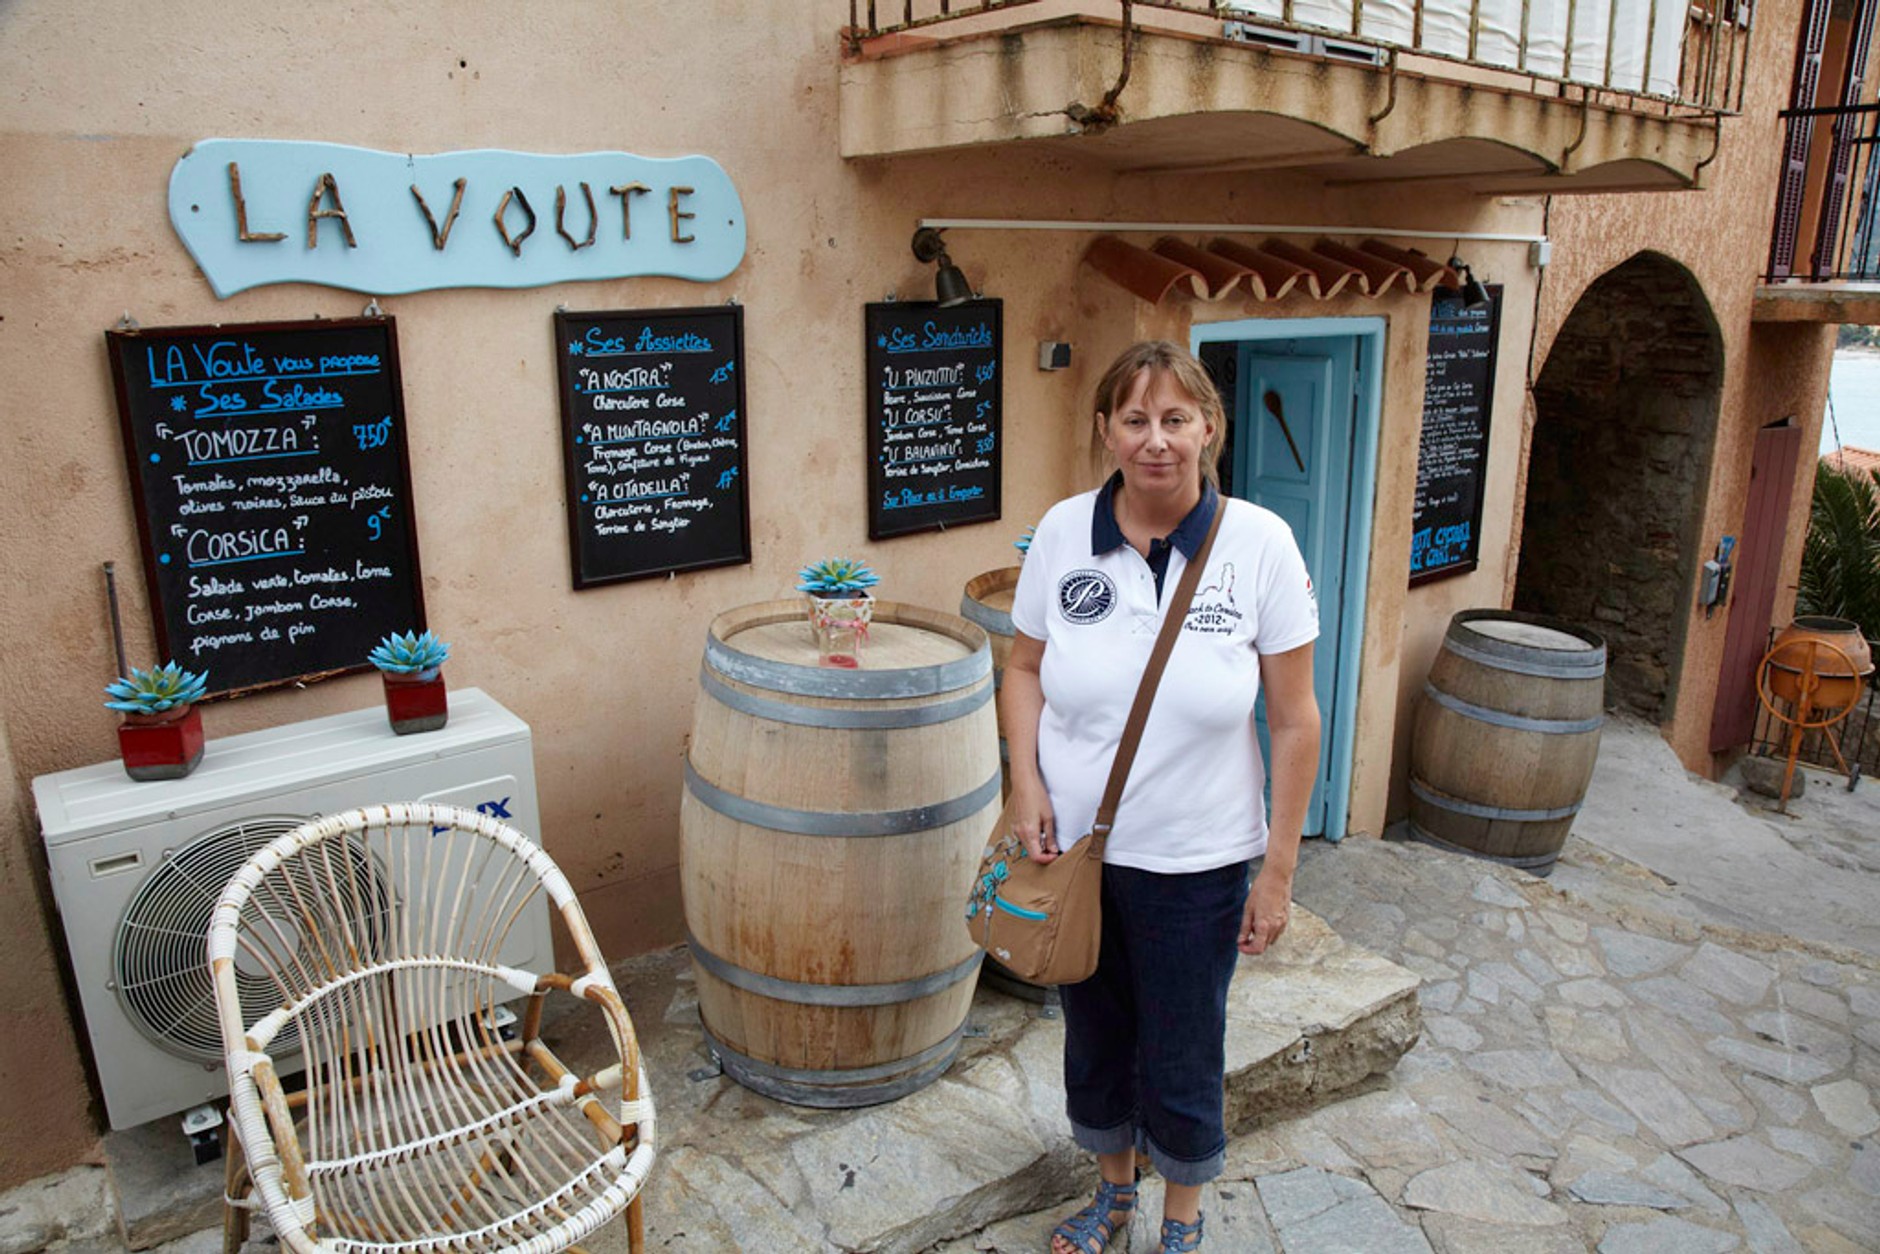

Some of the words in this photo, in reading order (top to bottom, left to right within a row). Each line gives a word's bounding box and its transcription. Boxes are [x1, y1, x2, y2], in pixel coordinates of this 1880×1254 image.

[228, 161, 357, 249] LA
[410, 176, 697, 258] VOUTE
[585, 327, 625, 354] Ses
[635, 326, 712, 351] Assiettes
[147, 345, 188, 384] LA
[193, 342, 265, 377] Voute
[274, 357, 313, 373] vous
[320, 355, 380, 373] propose
[195, 383, 247, 414] Ses
[260, 379, 343, 408] Salades
[656, 392, 686, 409] Corse
[593, 446, 638, 462] Fromage
[644, 442, 672, 454] Corse
[664, 456, 675, 466] de
[179, 500, 225, 515] olives
[330, 492, 348, 504] au
[350, 484, 393, 510] pistou
[634, 520, 646, 532] de
[188, 576, 244, 598] Salade
[356, 559, 392, 578] tome
[1199, 614, 1222, 625] 2012
[189, 632, 253, 656] pignons
[260, 626, 280, 640] de
[288, 621, 315, 645] pin
